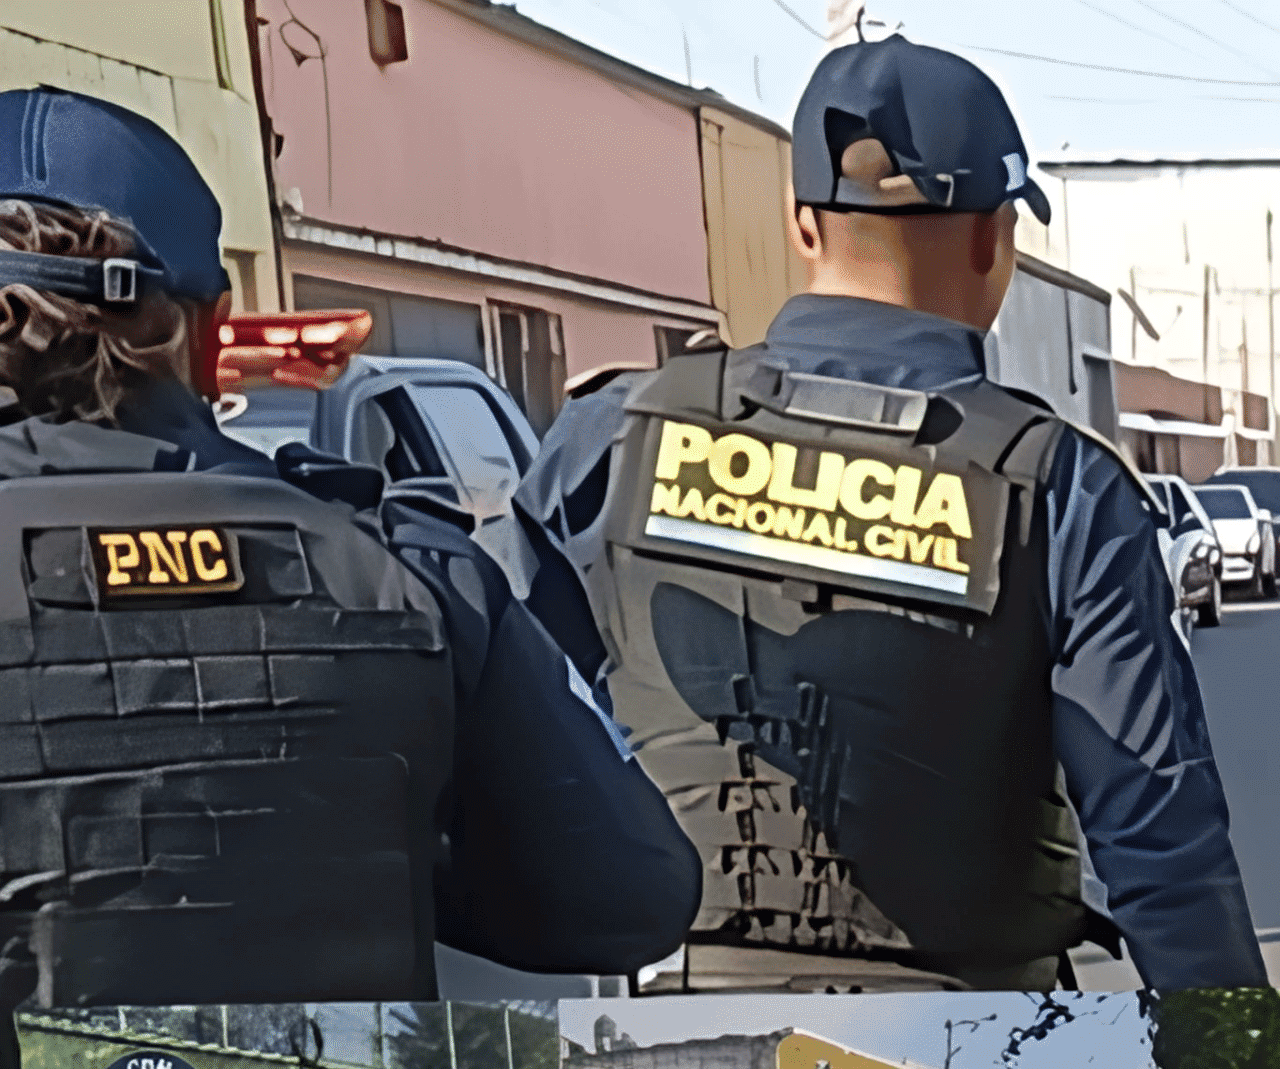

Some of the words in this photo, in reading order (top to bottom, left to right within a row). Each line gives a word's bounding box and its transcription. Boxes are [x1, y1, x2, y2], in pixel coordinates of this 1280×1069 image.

[655, 419, 973, 539] POLICIA
[99, 529, 229, 586] PNC
[650, 481, 859, 552] NACIONAL
[863, 523, 971, 574] CIVIL
